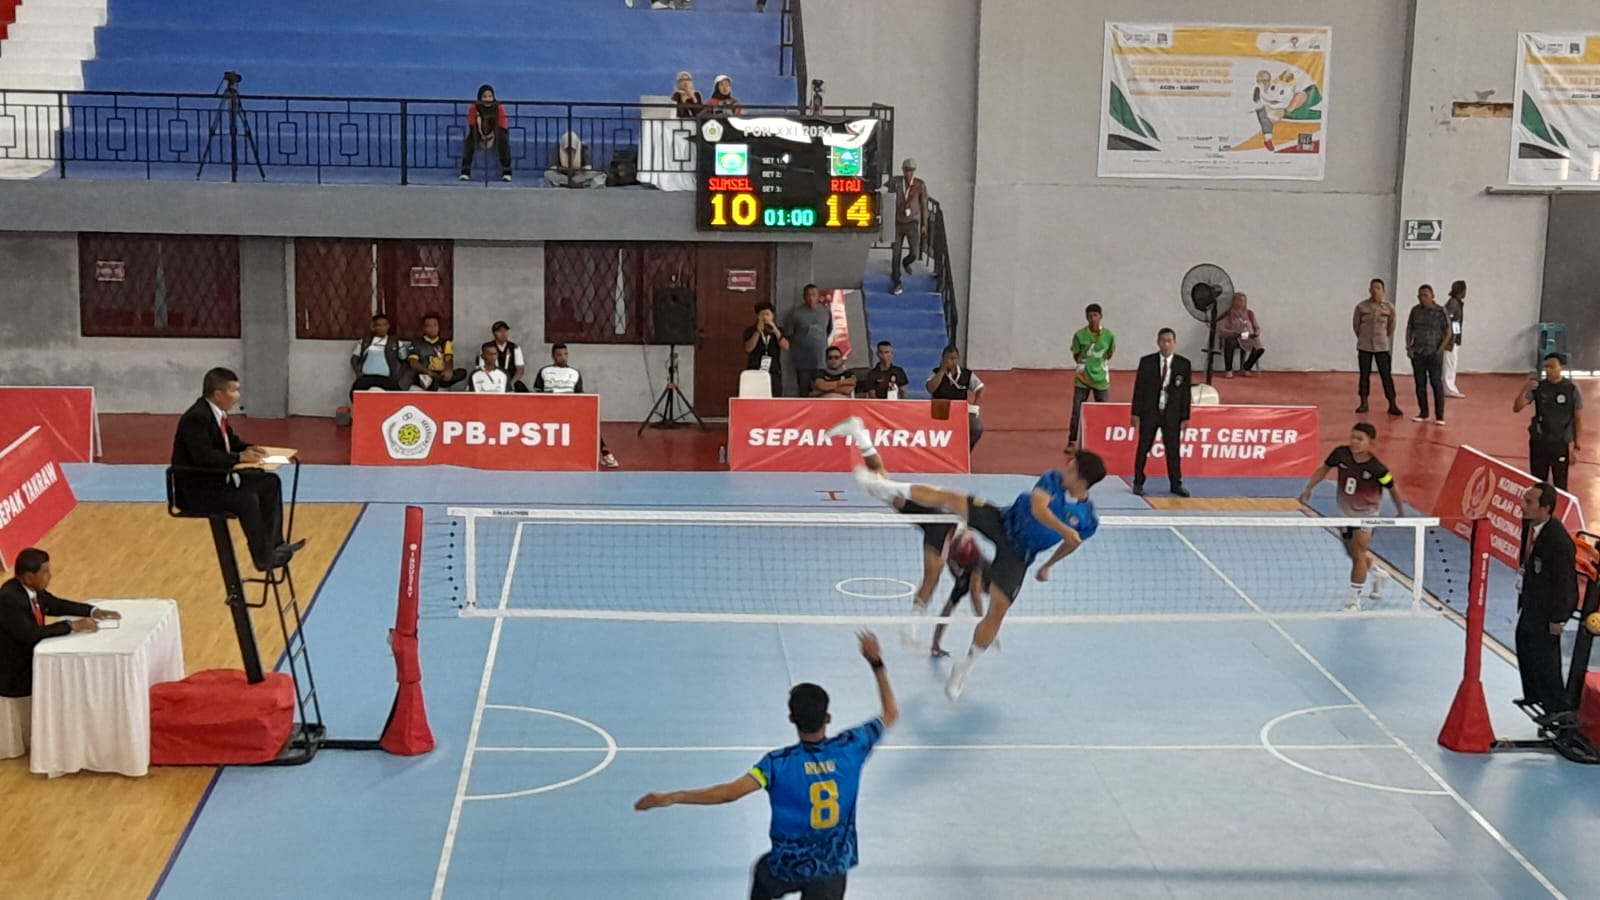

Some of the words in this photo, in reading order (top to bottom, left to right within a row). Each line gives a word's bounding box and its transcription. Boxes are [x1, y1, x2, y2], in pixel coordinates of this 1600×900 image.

[743, 125, 771, 137] PON
[802, 125, 833, 137] 2024
[708, 178, 753, 191] SUMSEL
[762, 185, 774, 193] SET
[831, 180, 861, 192] RIAU
[711, 194, 756, 225] 10
[764, 209, 814, 226] 01:00
[826, 195, 871, 226] 14
[443, 421, 571, 446] PB.PSTI
[748, 428, 833, 447] SEPAK
[1105, 426, 1134, 441] IDI
[1217, 429, 1298, 444] CENTER
[1201, 444, 1267, 460] TIMUR
[22, 461, 58, 504] TAKRAW
[1345, 476, 1357, 495] 8
[804, 761, 836, 774] RIAU
[810, 780, 838, 829] 8
